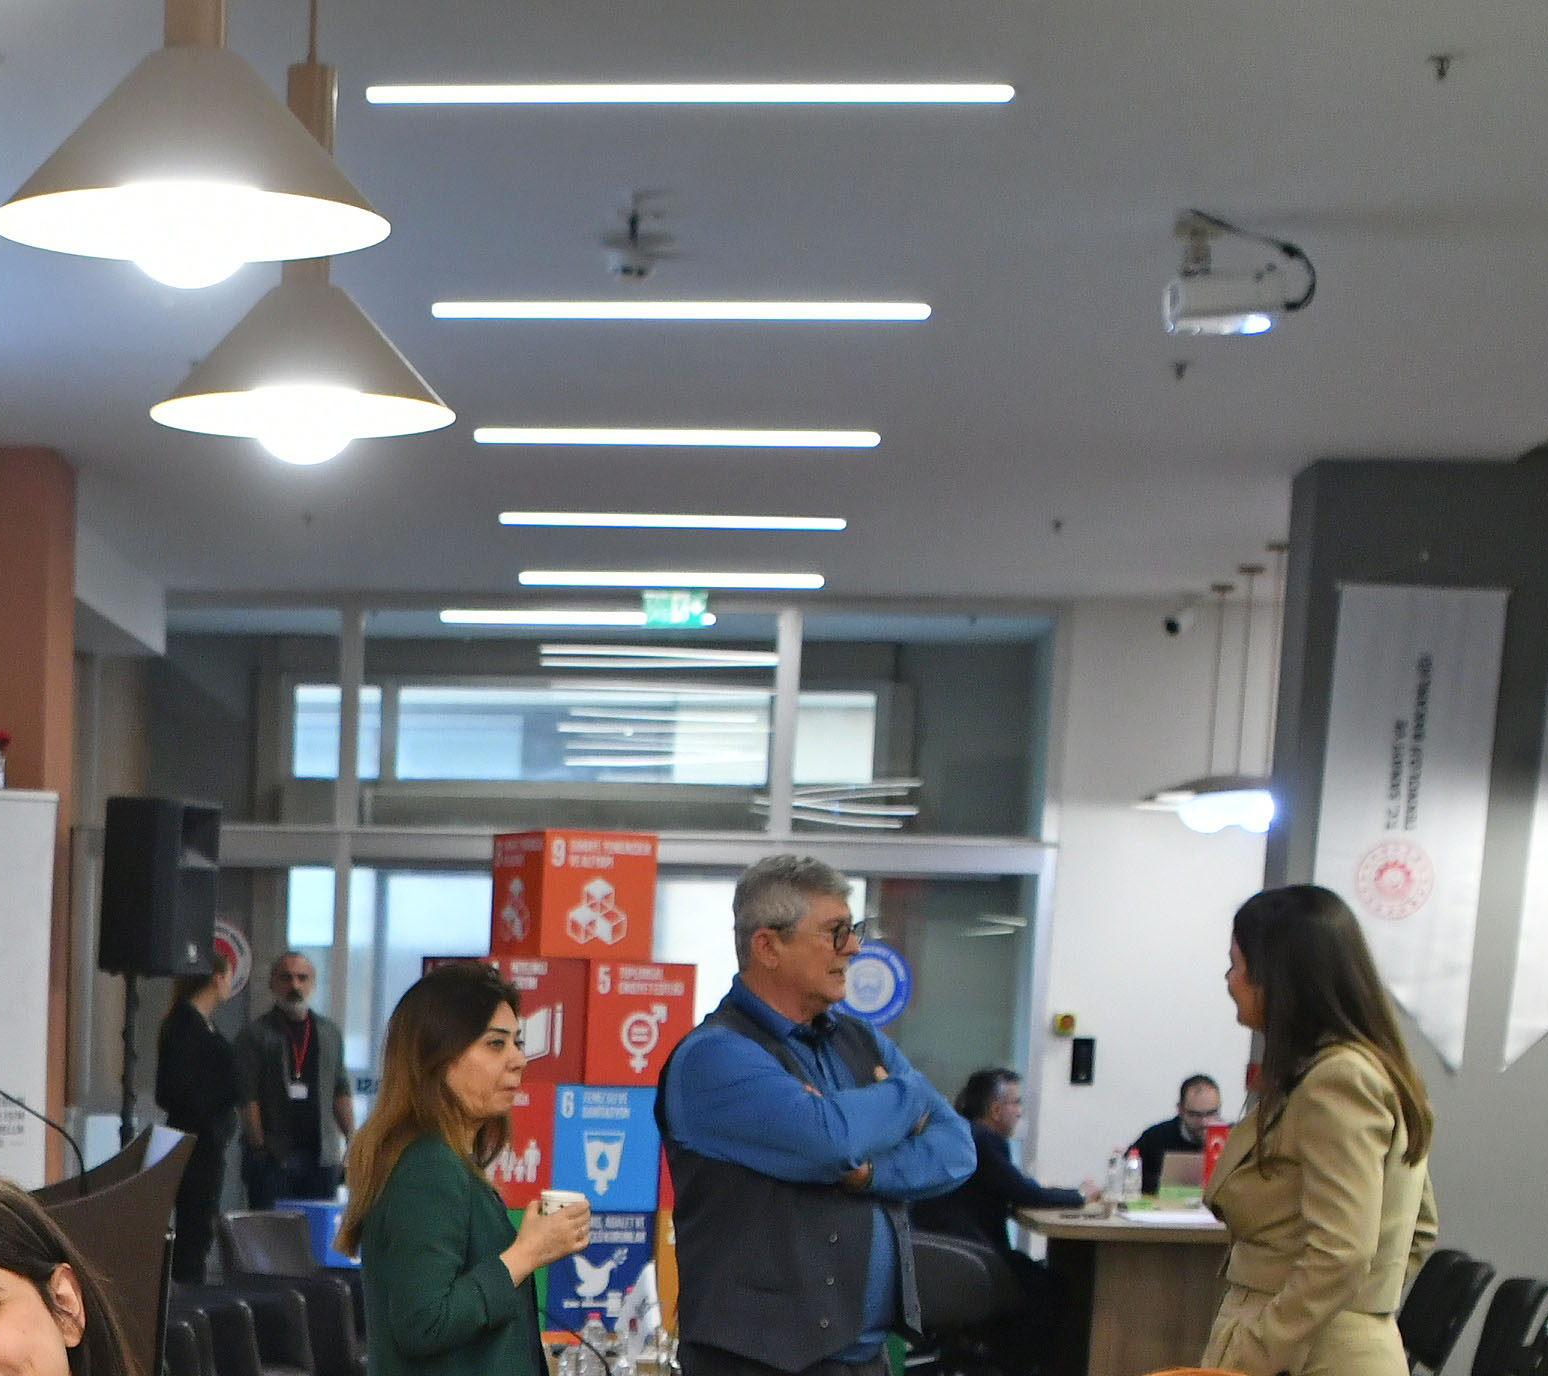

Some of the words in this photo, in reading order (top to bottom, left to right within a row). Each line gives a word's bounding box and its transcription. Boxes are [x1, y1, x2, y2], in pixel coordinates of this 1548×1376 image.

[551, 837, 567, 867] 9
[598, 965, 612, 994] 5
[561, 1090, 575, 1118] 6
